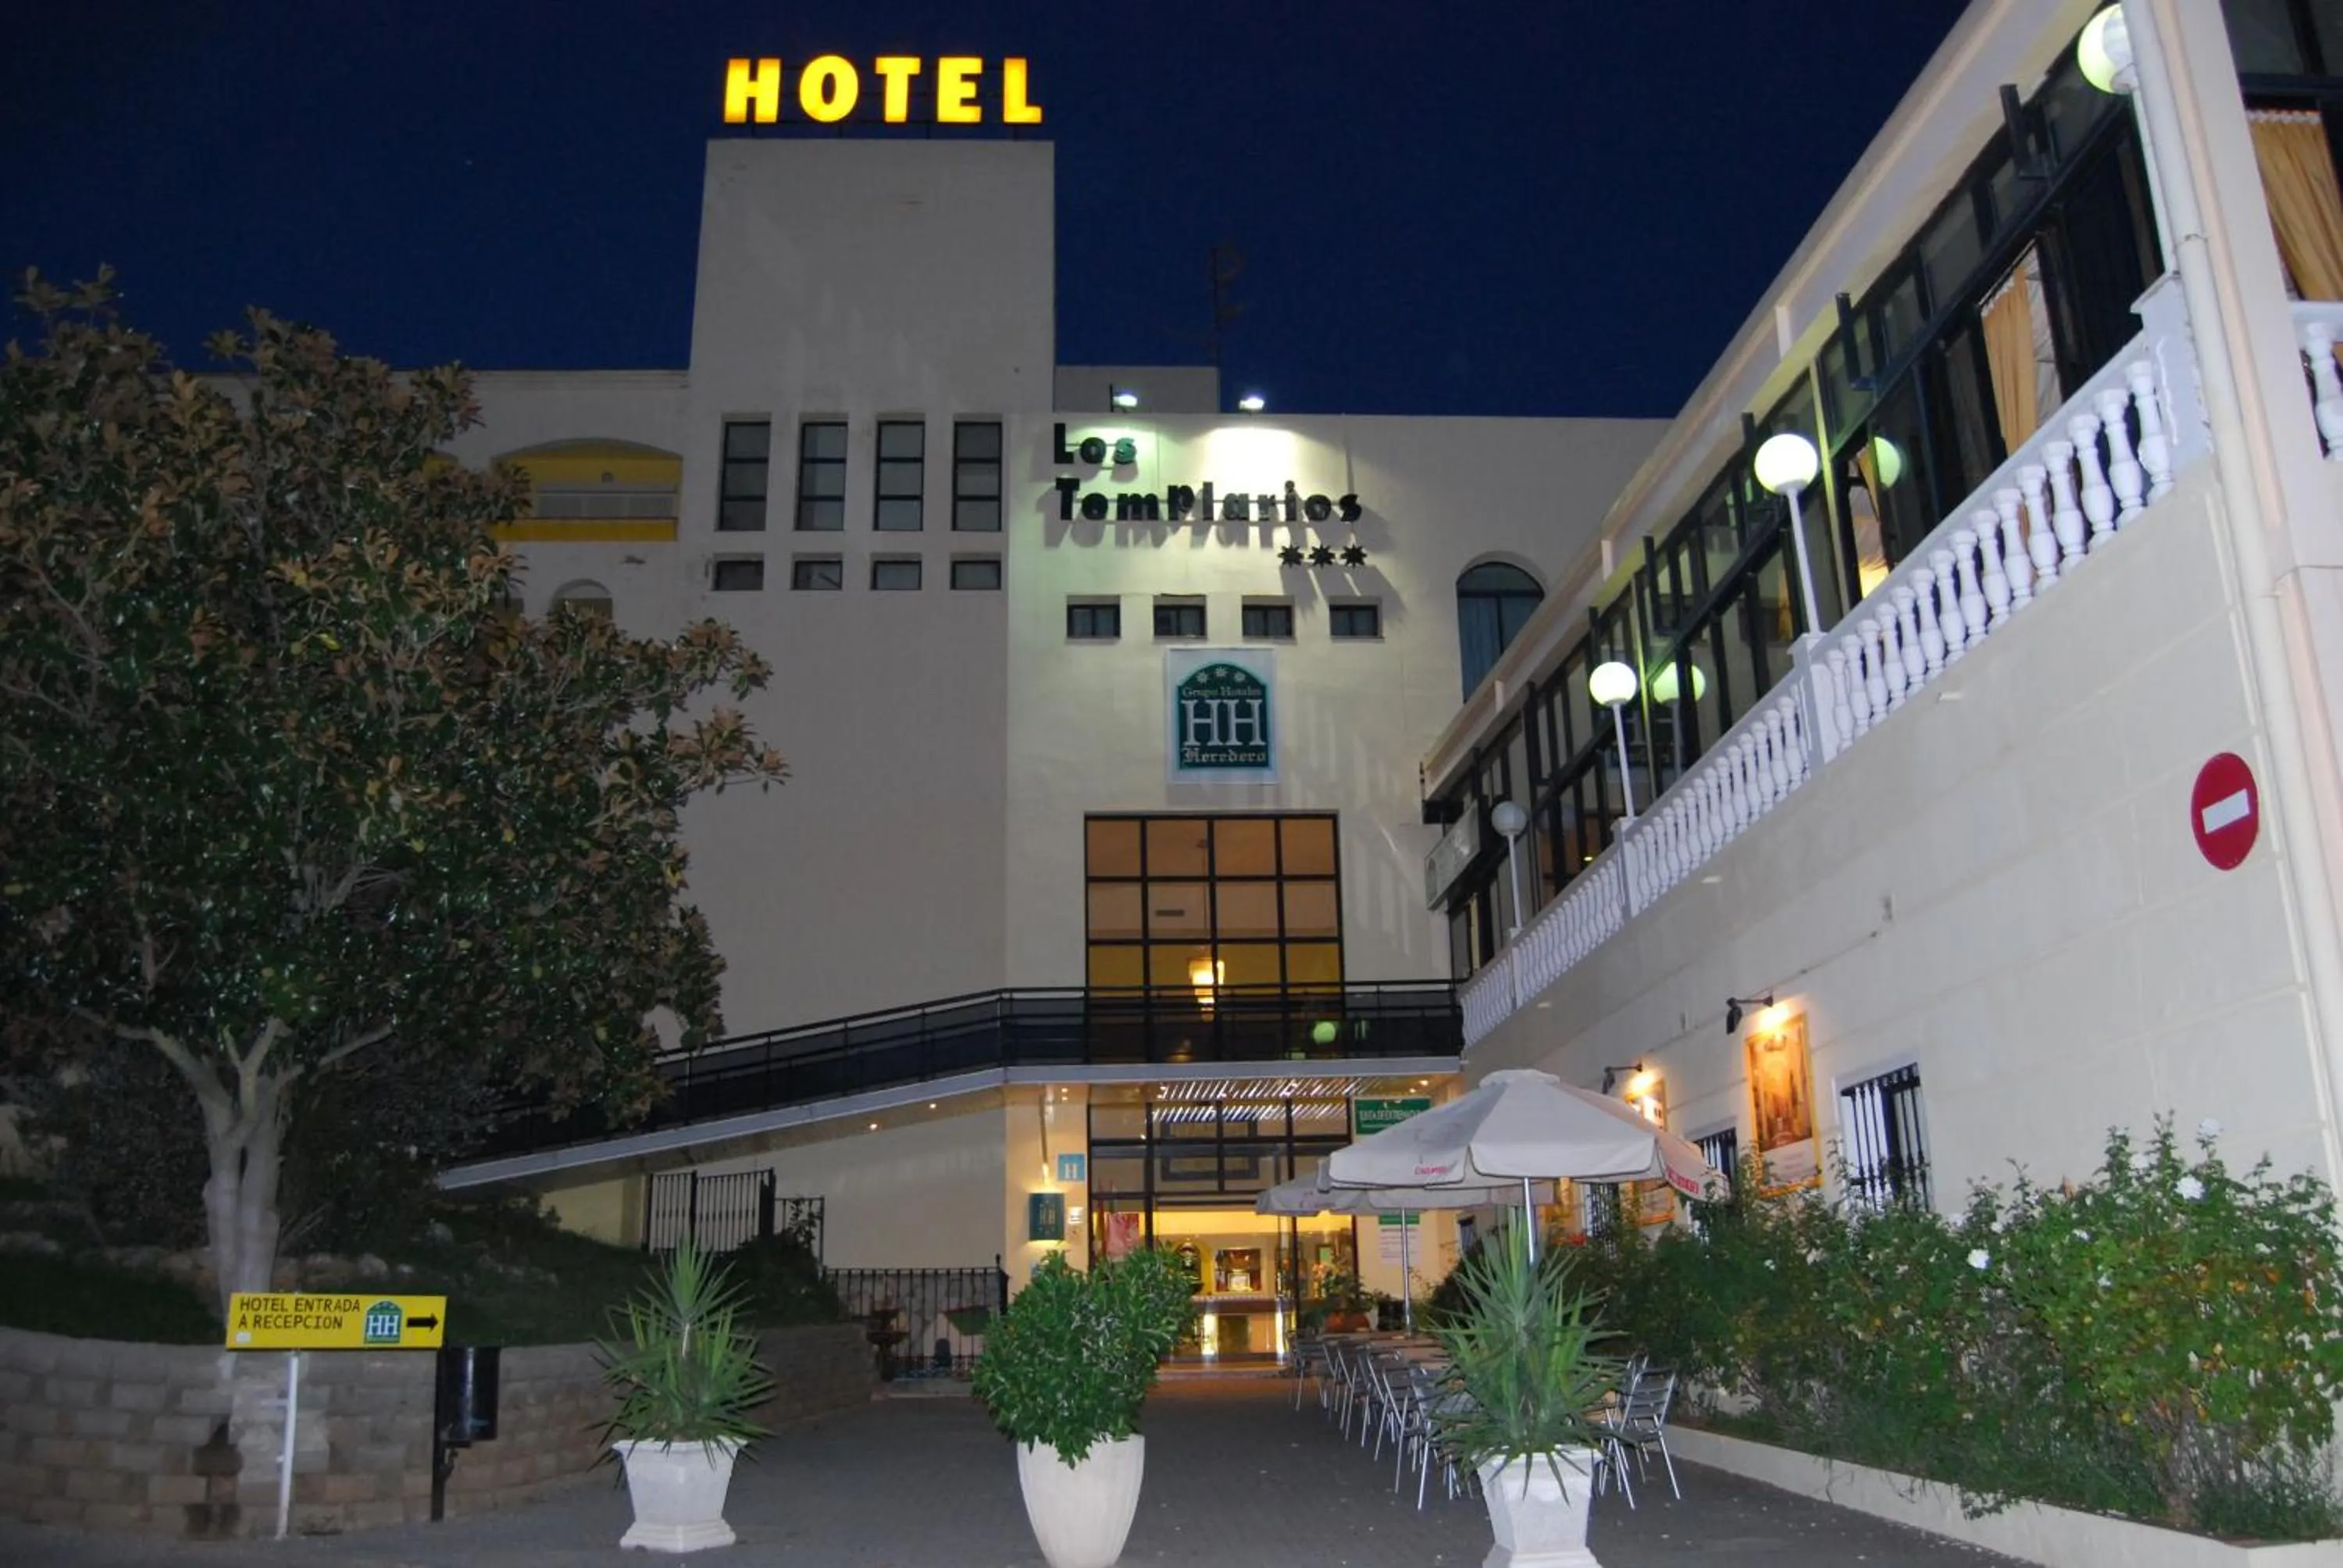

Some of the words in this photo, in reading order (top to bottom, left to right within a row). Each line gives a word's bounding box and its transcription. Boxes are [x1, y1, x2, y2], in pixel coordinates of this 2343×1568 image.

[725, 55, 1042, 123] HOTEL
[1054, 422, 1137, 465] Los
[1182, 699, 1266, 747] HH
[239, 1297, 287, 1312] HOTEL
[294, 1298, 361, 1313] ENTRADA
[238, 1313, 248, 1329] A
[252, 1314, 344, 1330] RECEPCION
[366, 1315, 398, 1335] HH
